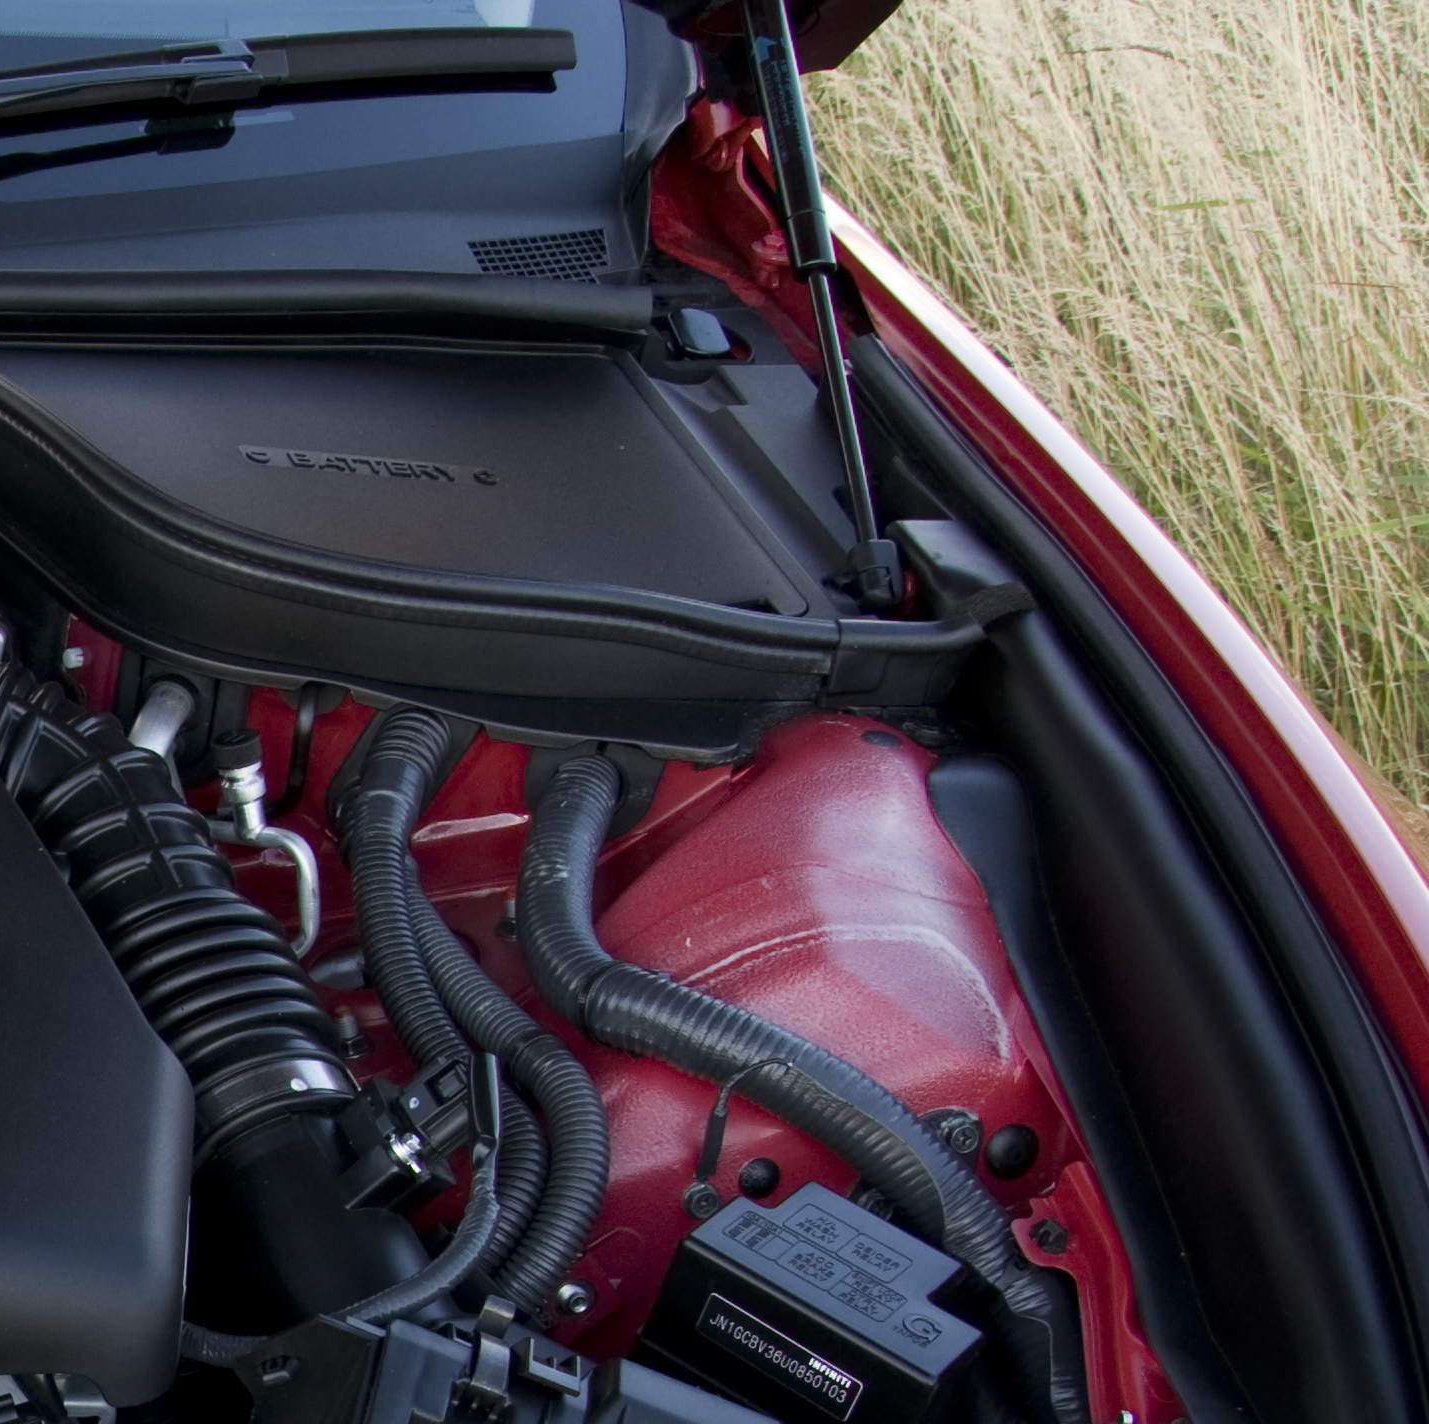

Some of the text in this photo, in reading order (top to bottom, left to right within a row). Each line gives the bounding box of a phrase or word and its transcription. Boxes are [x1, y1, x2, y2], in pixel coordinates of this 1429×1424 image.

[287, 451, 455, 482] BATTERY
[796, 1220, 836, 1246] RELAY
[788, 1258, 828, 1283] RELAY
[852, 1247, 891, 1272] RELAY
[709, 1314, 847, 1404] JN1GCBV36U0850103
[808, 1358, 852, 1388] INFINITI
